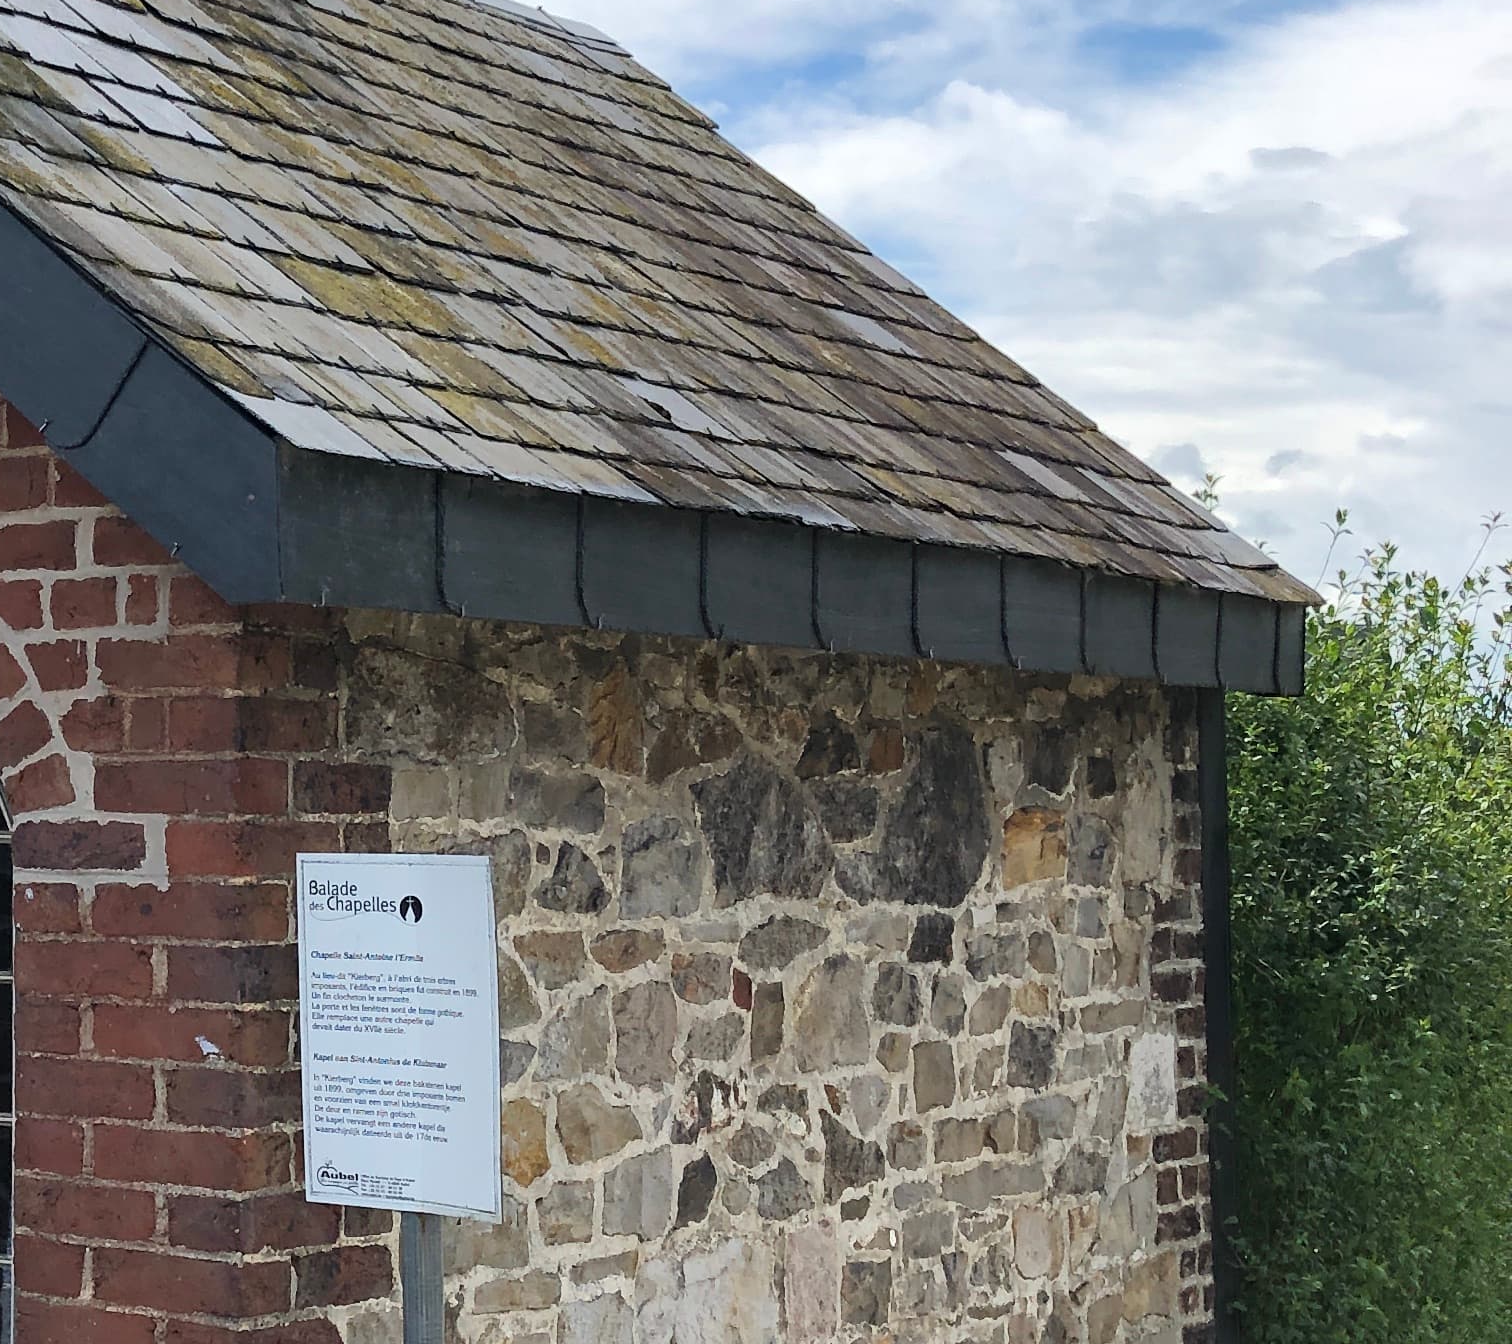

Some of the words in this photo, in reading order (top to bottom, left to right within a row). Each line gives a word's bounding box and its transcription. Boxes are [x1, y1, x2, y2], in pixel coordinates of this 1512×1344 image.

[309, 880, 358, 896] Balade
[309, 901, 324, 911] des
[326, 896, 397, 915] Chapelles
[311, 951, 342, 960] Chapelle
[344, 952, 393, 960] Saint-Antoine
[389, 986, 414, 994] briques
[333, 993, 366, 1001] clocheton
[327, 1014, 358, 1022] remplace
[394, 1017, 424, 1025] chapelle
[314, 1053, 334, 1062] Kapel
[446, 1083, 462, 1092] kapel
[326, 1116, 344, 1124] kapel
[346, 1118, 376, 1128] vervangt
[418, 1122, 436, 1131] kapel
[362, 1129, 392, 1138] dateerde
[320, 1170, 358, 1181] Aubel
